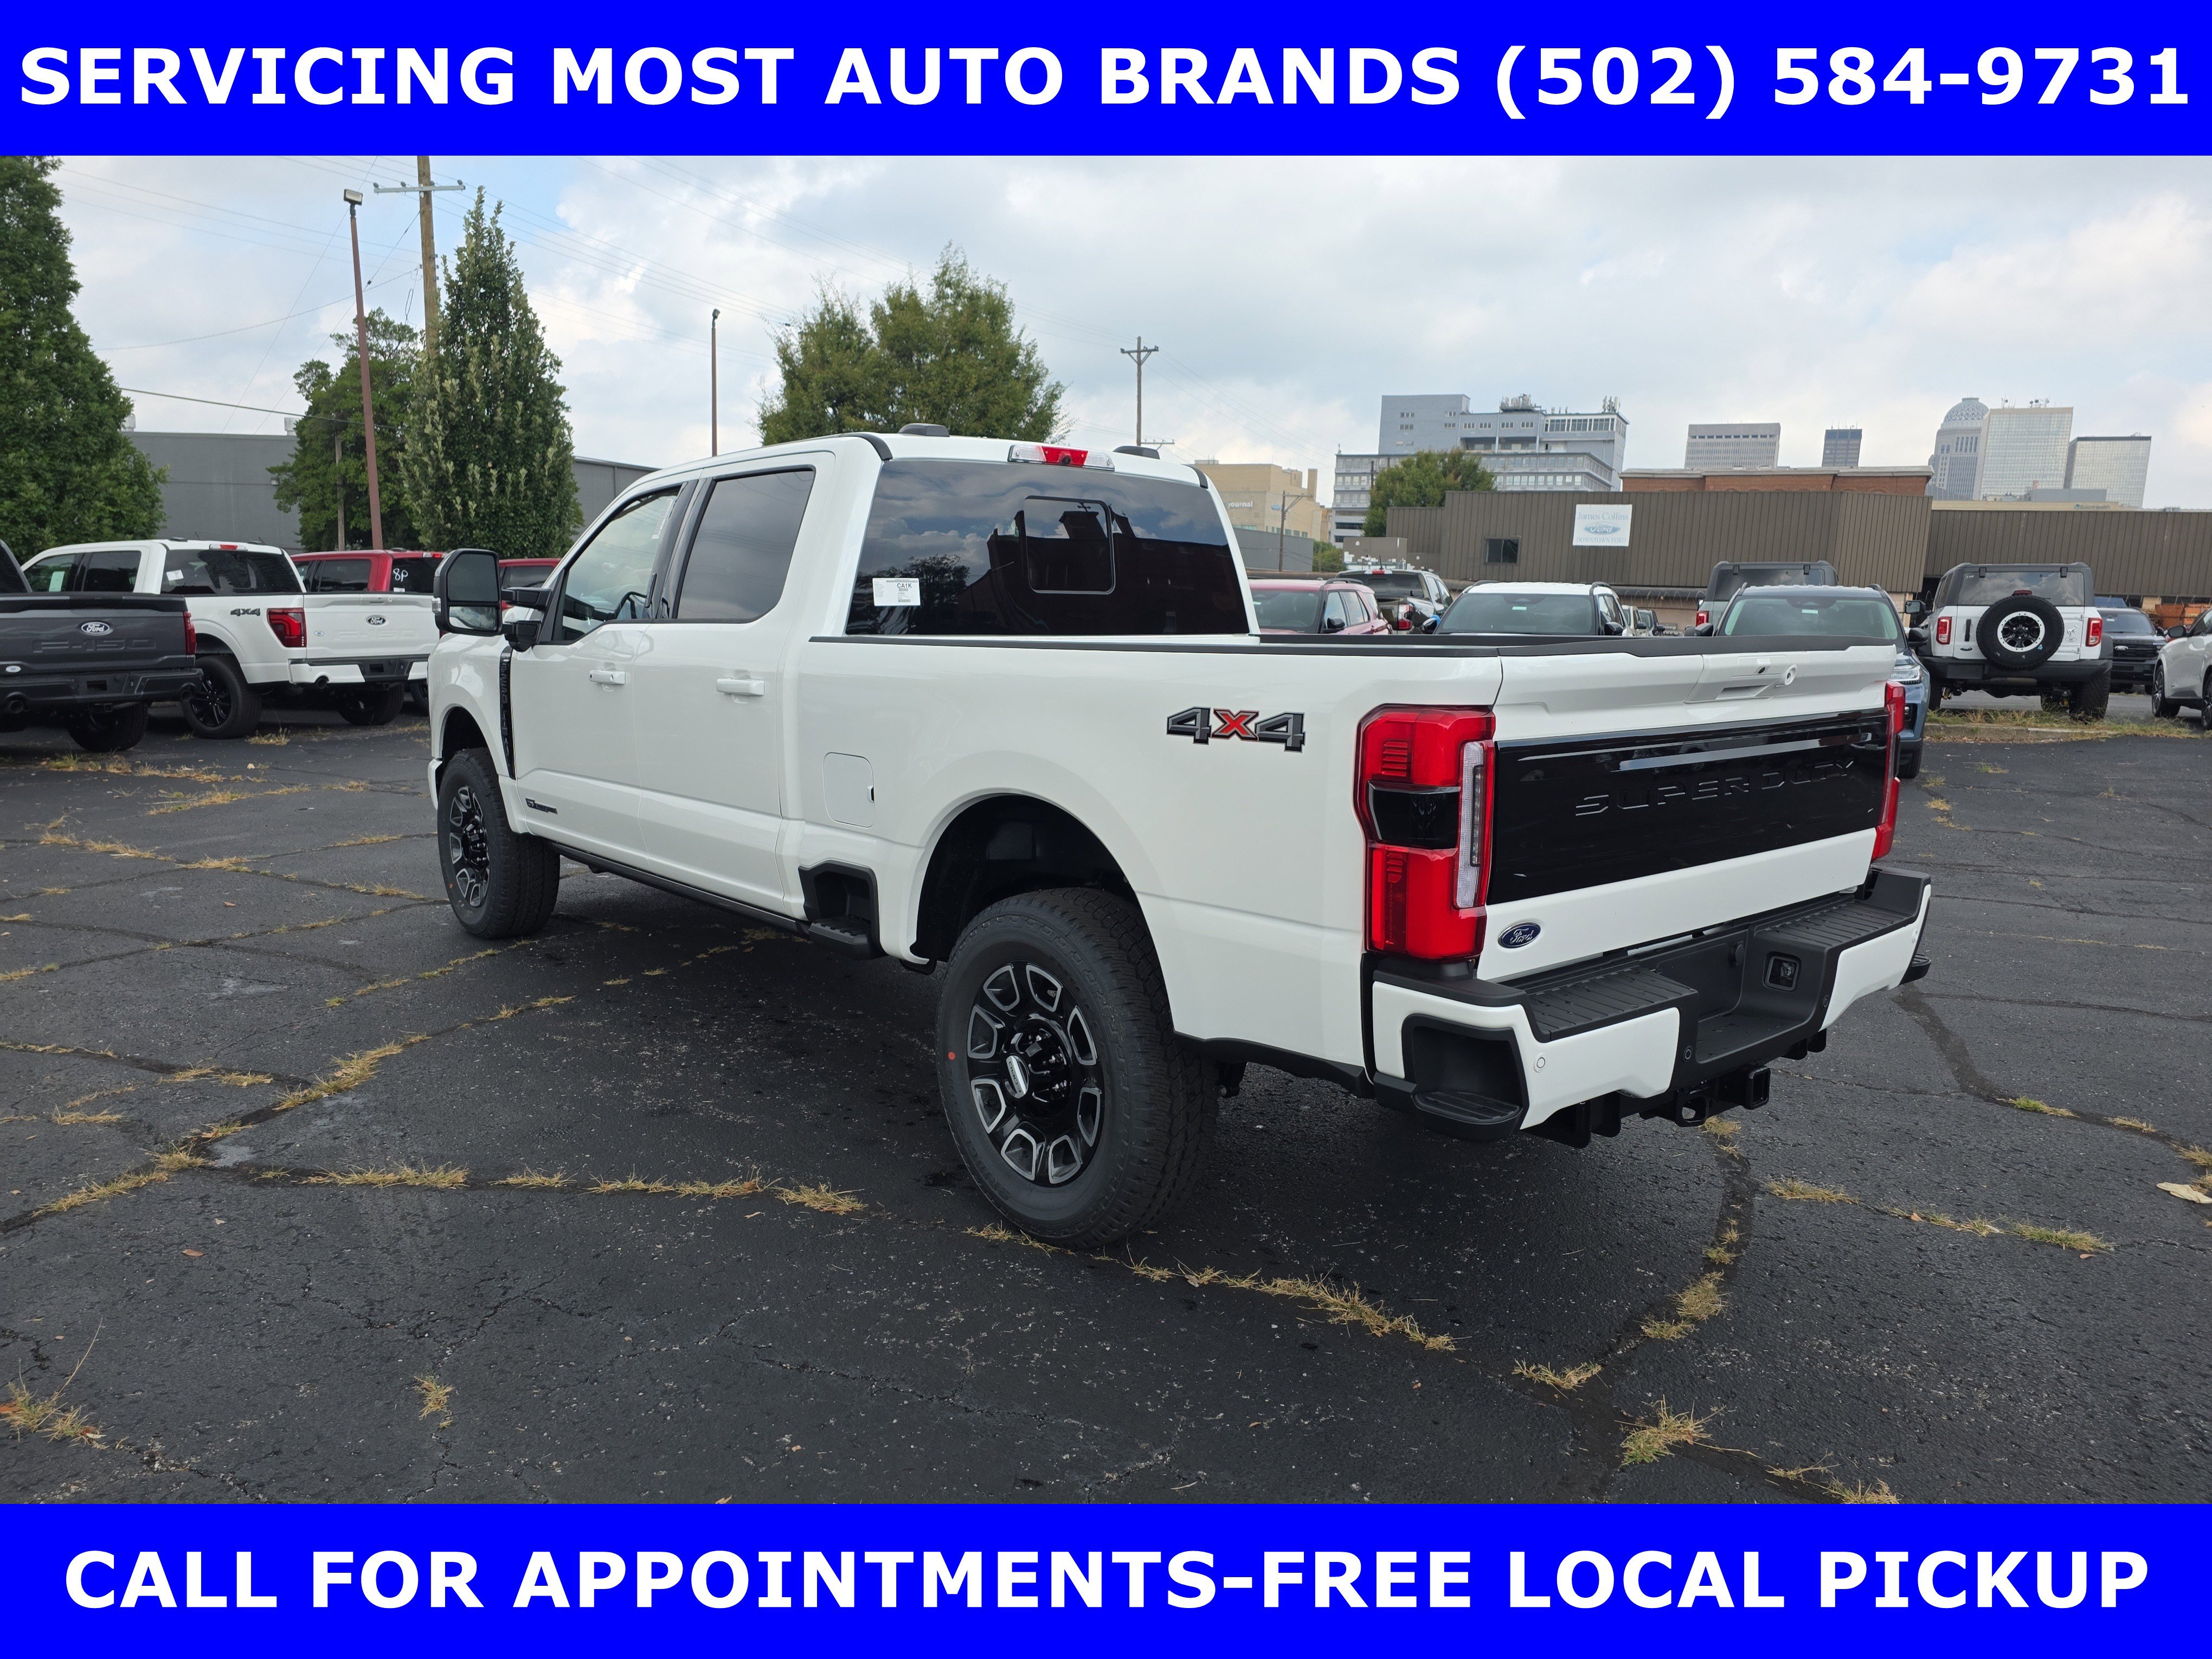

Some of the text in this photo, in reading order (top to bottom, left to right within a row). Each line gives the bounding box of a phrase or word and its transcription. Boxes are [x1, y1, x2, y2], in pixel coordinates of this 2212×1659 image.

[1577, 512, 1629, 520] James Collins
[33, 639, 156, 653] F-150
[1576, 760, 1854, 816] SUPER DUTY
